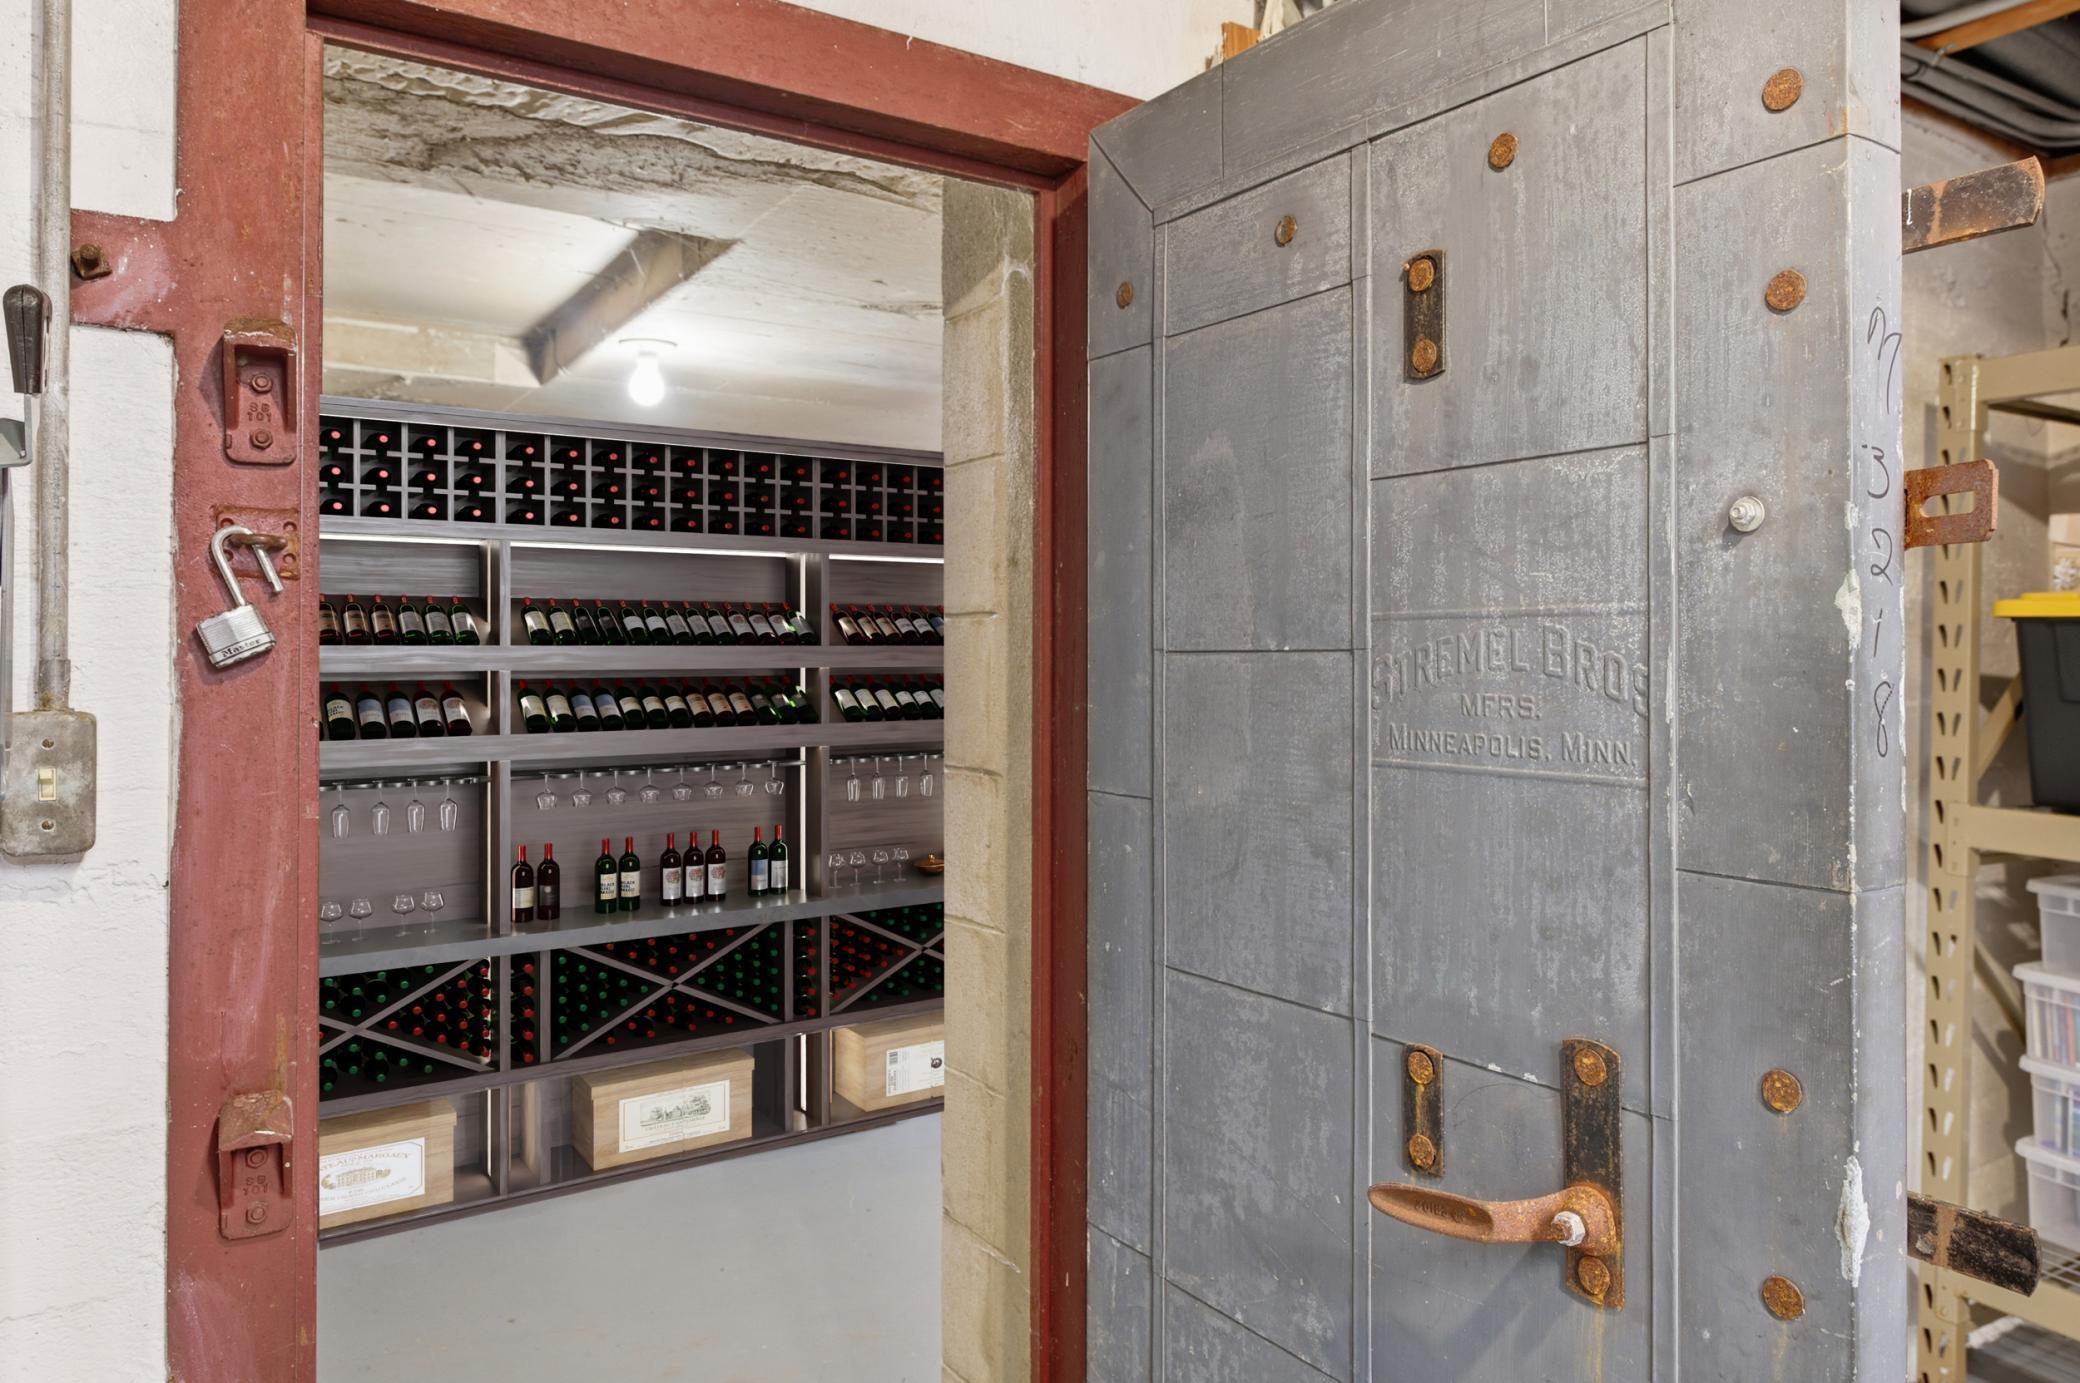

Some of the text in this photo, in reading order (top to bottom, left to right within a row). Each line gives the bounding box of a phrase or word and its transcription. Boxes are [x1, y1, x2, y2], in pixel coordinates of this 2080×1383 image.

[221, 638, 261, 658] Master
[1371, 625, 1531, 711] STREMEL
[1460, 692, 1543, 720] MFRS.
[1389, 722, 1639, 767] MINNEAPOLIS, MINN.
